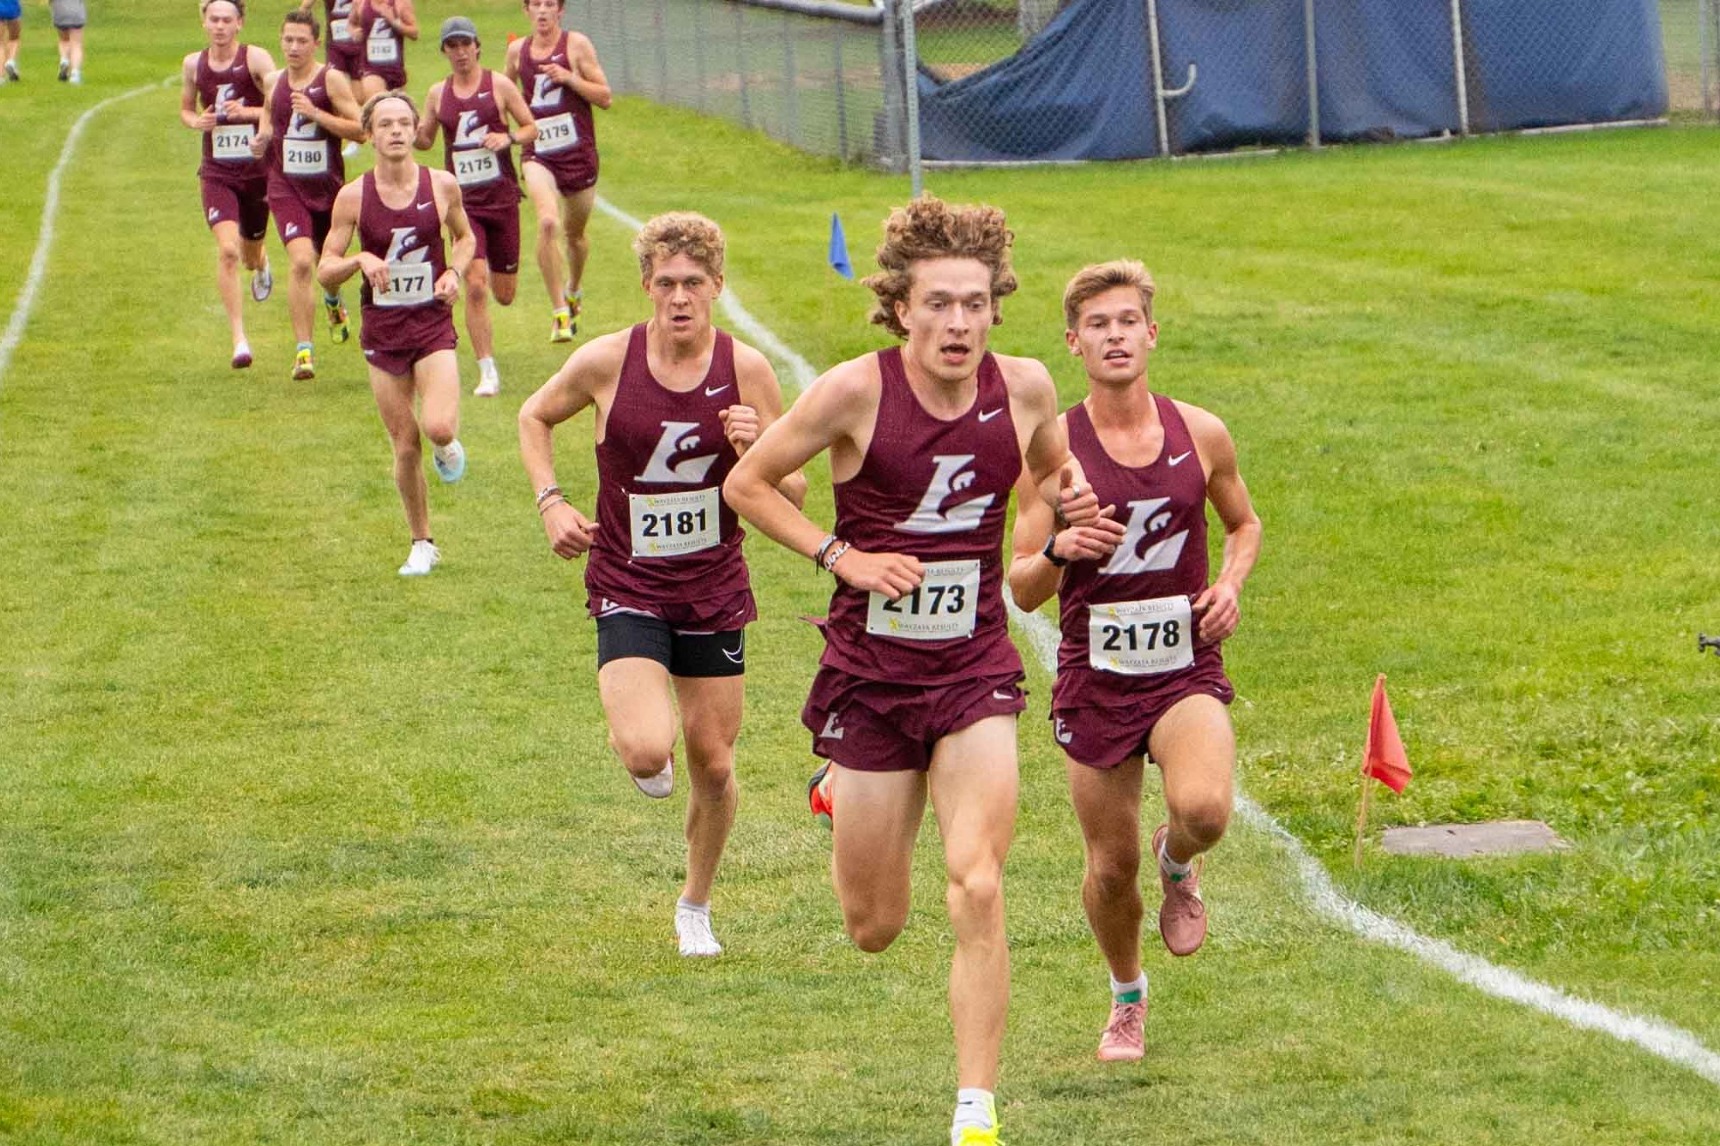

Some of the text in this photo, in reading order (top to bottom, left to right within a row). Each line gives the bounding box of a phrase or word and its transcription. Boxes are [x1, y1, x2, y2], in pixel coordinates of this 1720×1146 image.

[538, 124, 569, 141] 2179
[217, 135, 249, 148] 2174
[288, 150, 322, 163] 2180
[459, 156, 493, 174] 2175
[386, 276, 425, 292] 177
[642, 508, 706, 537] 2181
[1102, 619, 1180, 651] 2178
